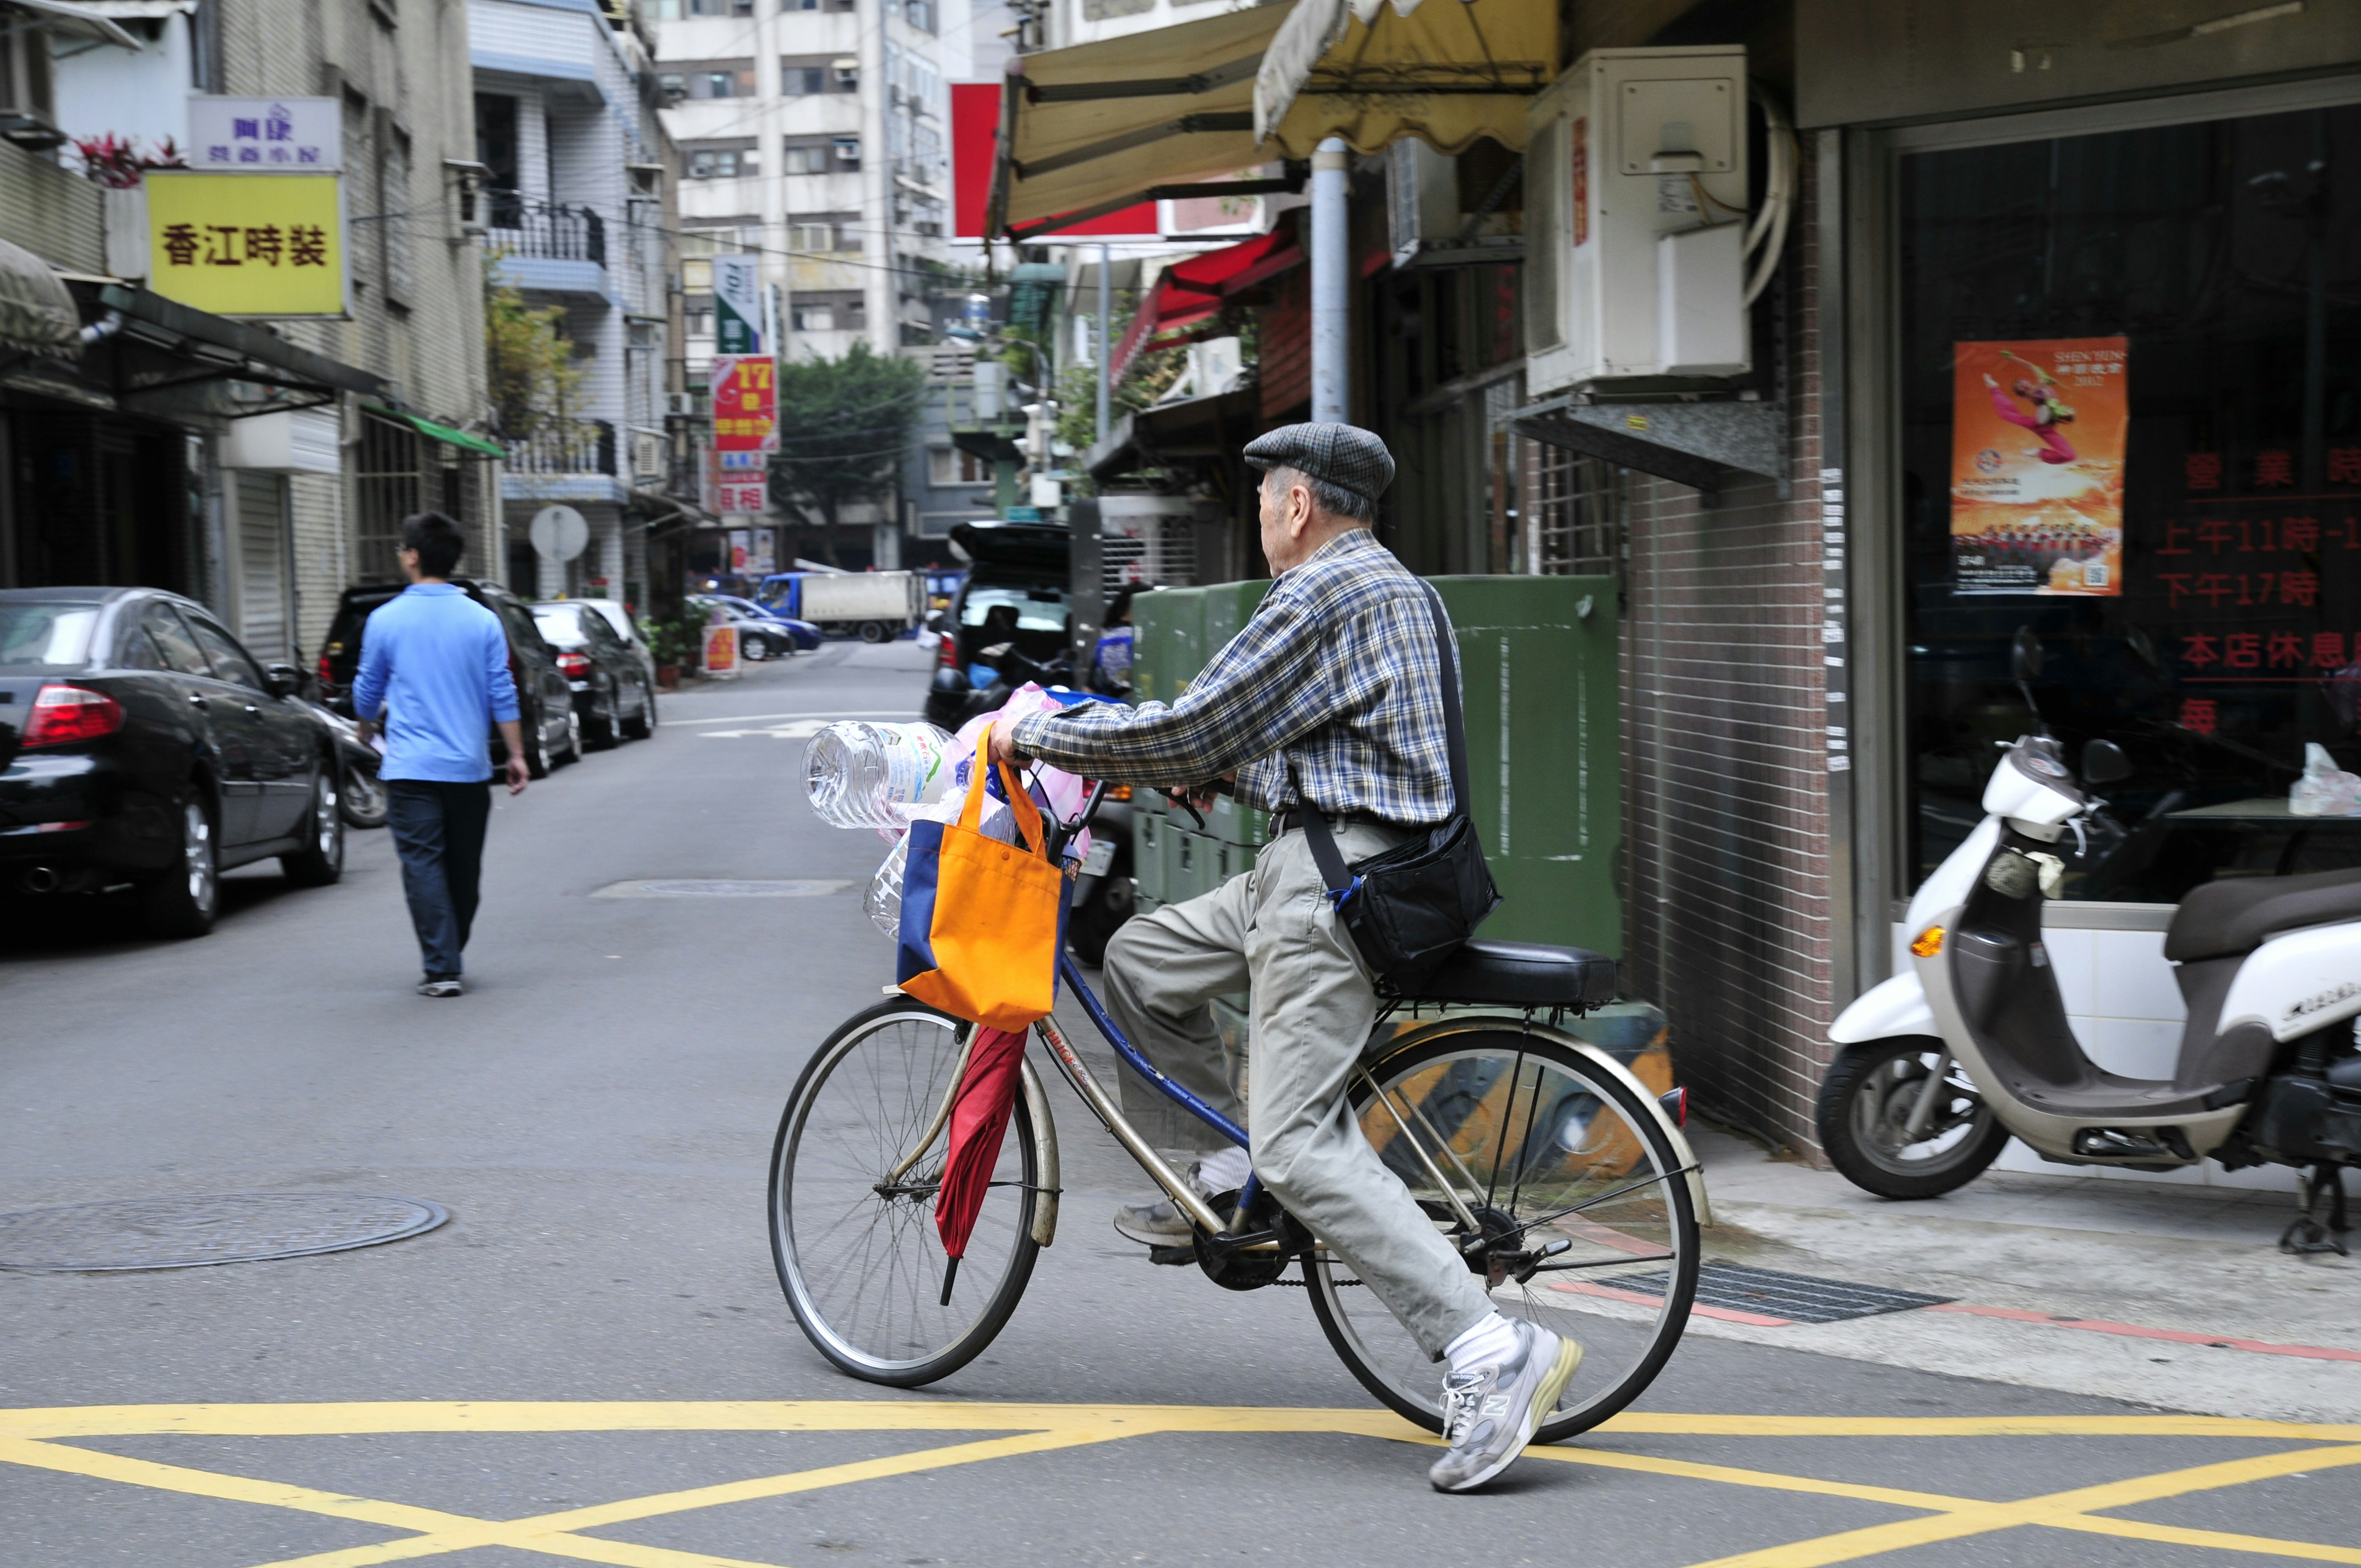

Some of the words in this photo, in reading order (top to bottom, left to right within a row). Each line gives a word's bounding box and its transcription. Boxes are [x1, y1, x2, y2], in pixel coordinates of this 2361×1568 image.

[162, 223, 327, 267] 香江時裝
[736, 363, 772, 389] 17
[2157, 570, 2319, 607] 下午17時
[2182, 631, 2361, 668] 本店休息
